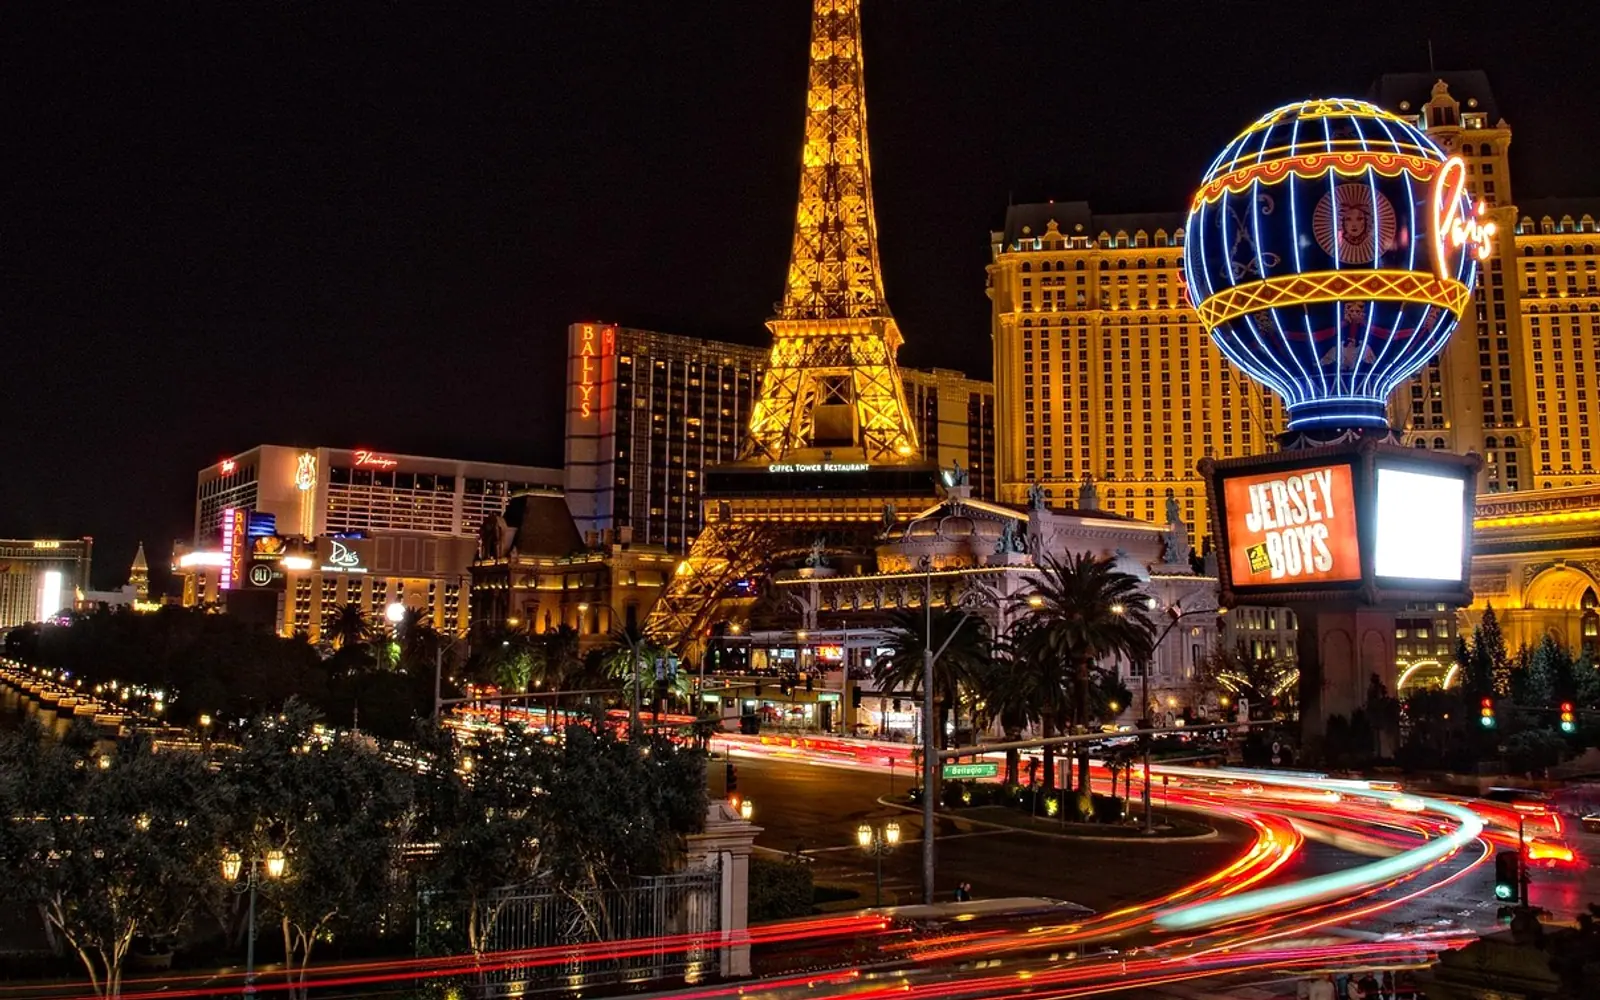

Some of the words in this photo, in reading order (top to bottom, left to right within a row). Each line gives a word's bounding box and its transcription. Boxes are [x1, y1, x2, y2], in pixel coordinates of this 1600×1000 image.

[1434, 157, 1496, 280] Paris
[769, 464, 794, 473] EIFFEL
[796, 464, 822, 472] TOWER
[824, 463, 870, 472] RESTAURANT
[1245, 469, 1334, 533] JERSEY
[254, 568, 267, 581] BLT
[1266, 522, 1333, 579] BOYS
